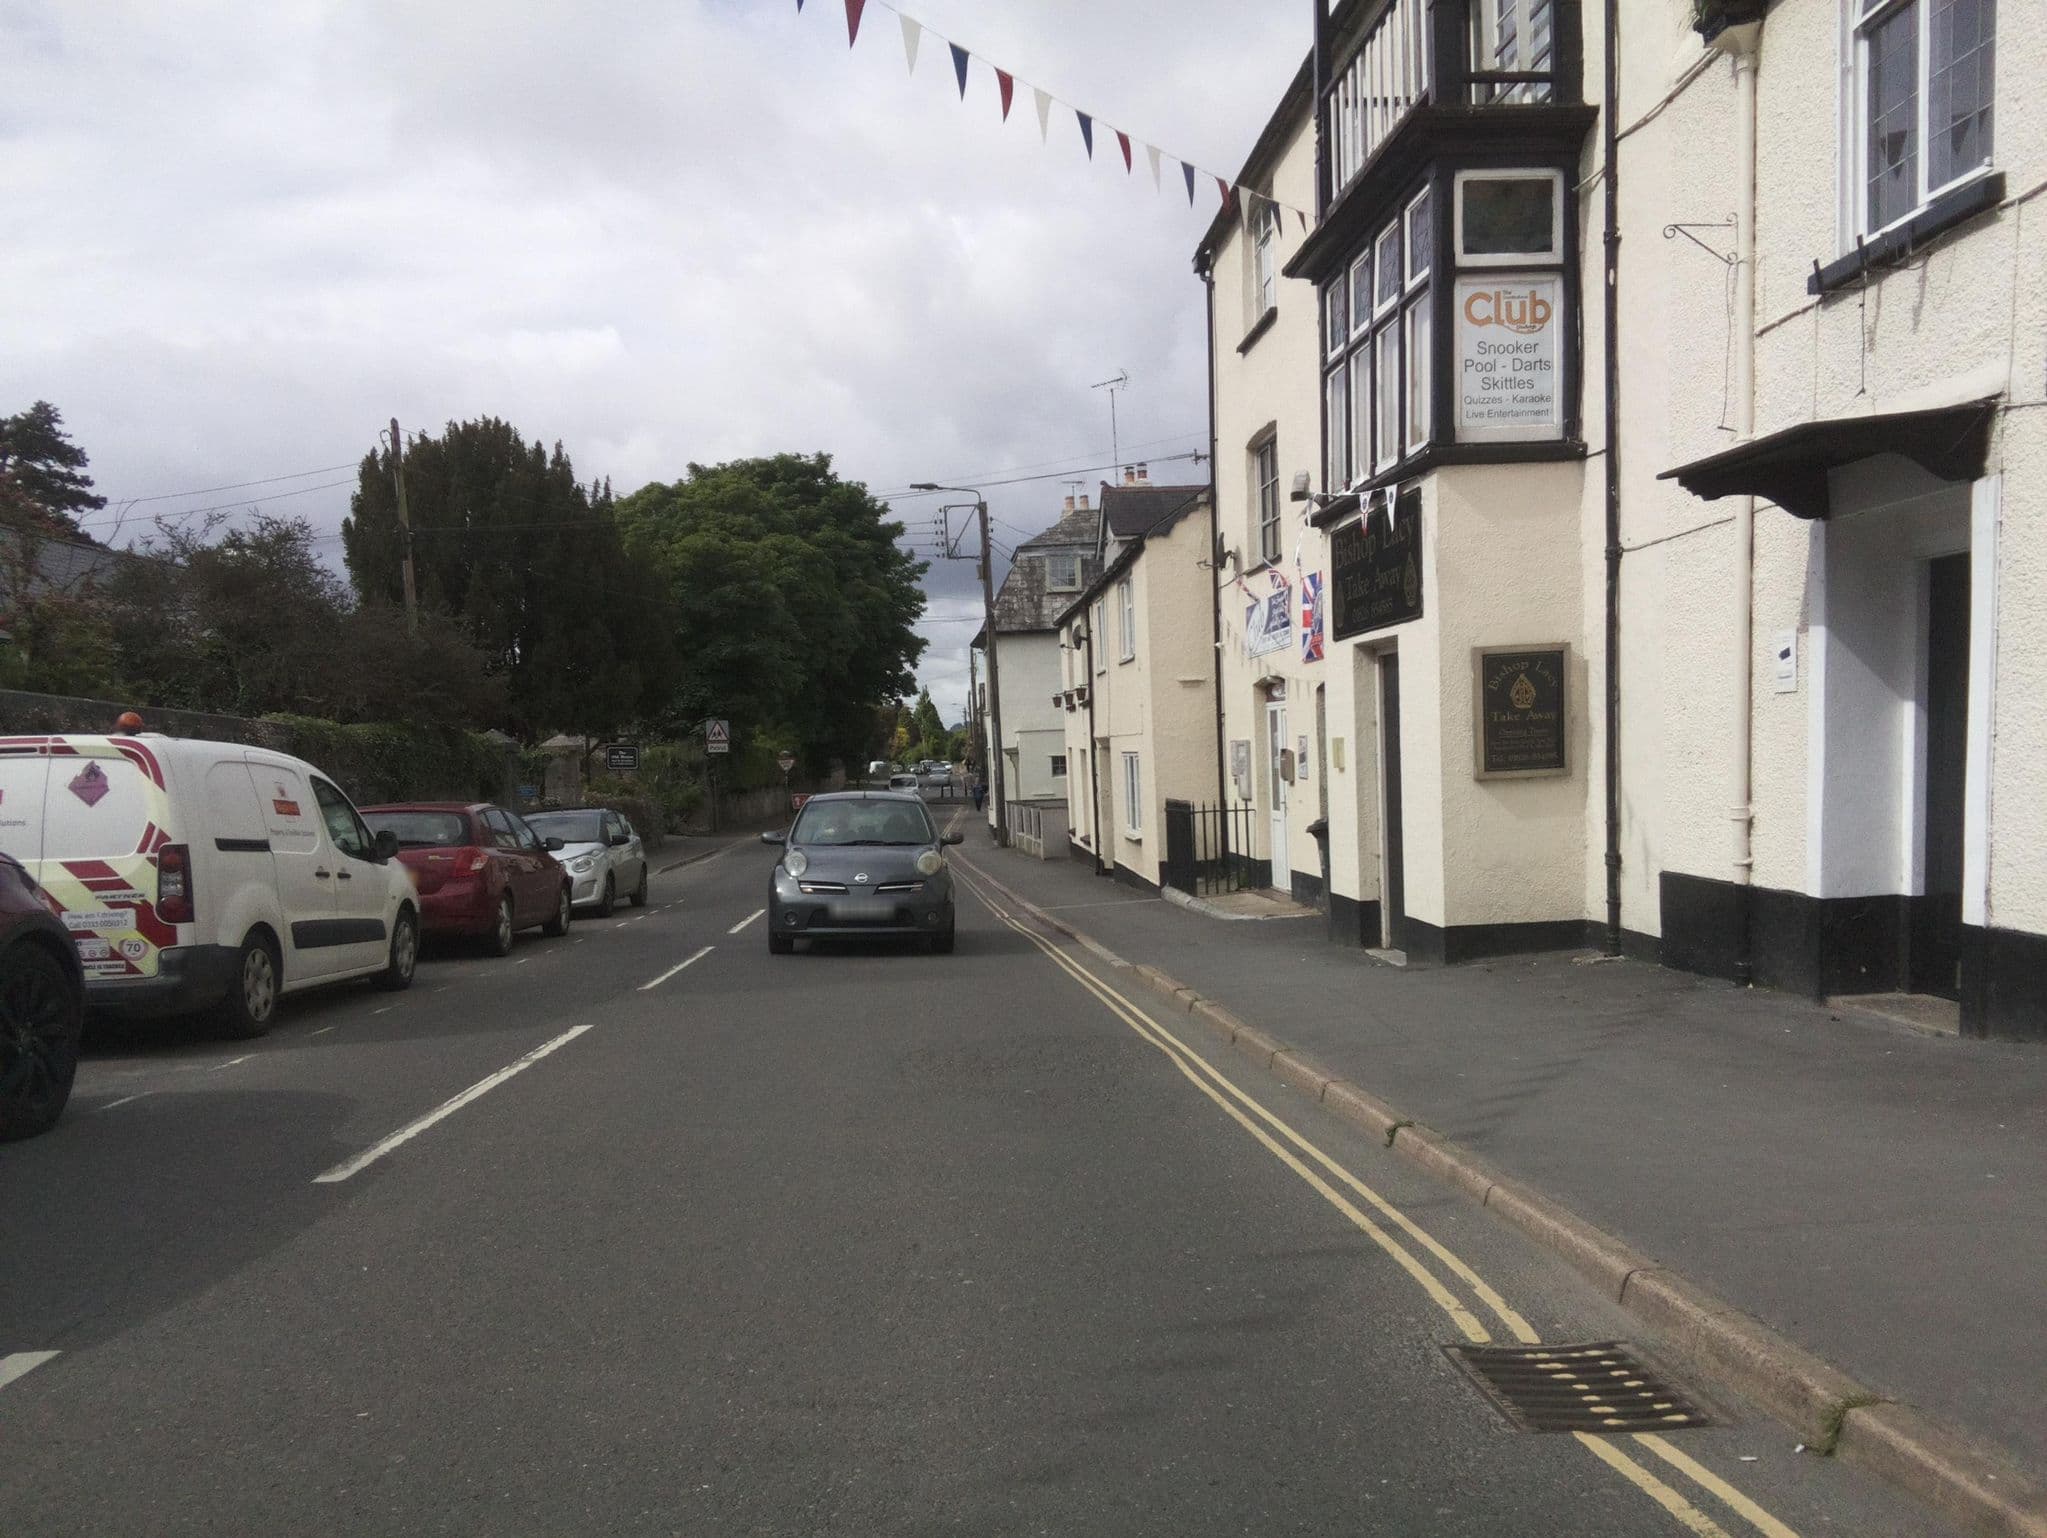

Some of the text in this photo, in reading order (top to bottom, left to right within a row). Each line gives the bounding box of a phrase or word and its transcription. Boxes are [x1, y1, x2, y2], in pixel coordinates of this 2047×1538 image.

[1464, 290, 1551, 327] Club
[1477, 341, 1539, 355] Snooker
[1464, 359, 1497, 373] Pool
[1512, 358, 1551, 371] Darts
[1481, 376, 1535, 391] Skittles
[1464, 395, 1503, 405] Quizzes
[1512, 394, 1551, 404] Karaoke
[1465, 408, 1549, 419] Live Entertainment
[1487, 660, 1529, 691] Bishop
[126, 943, 141, 953] 70
